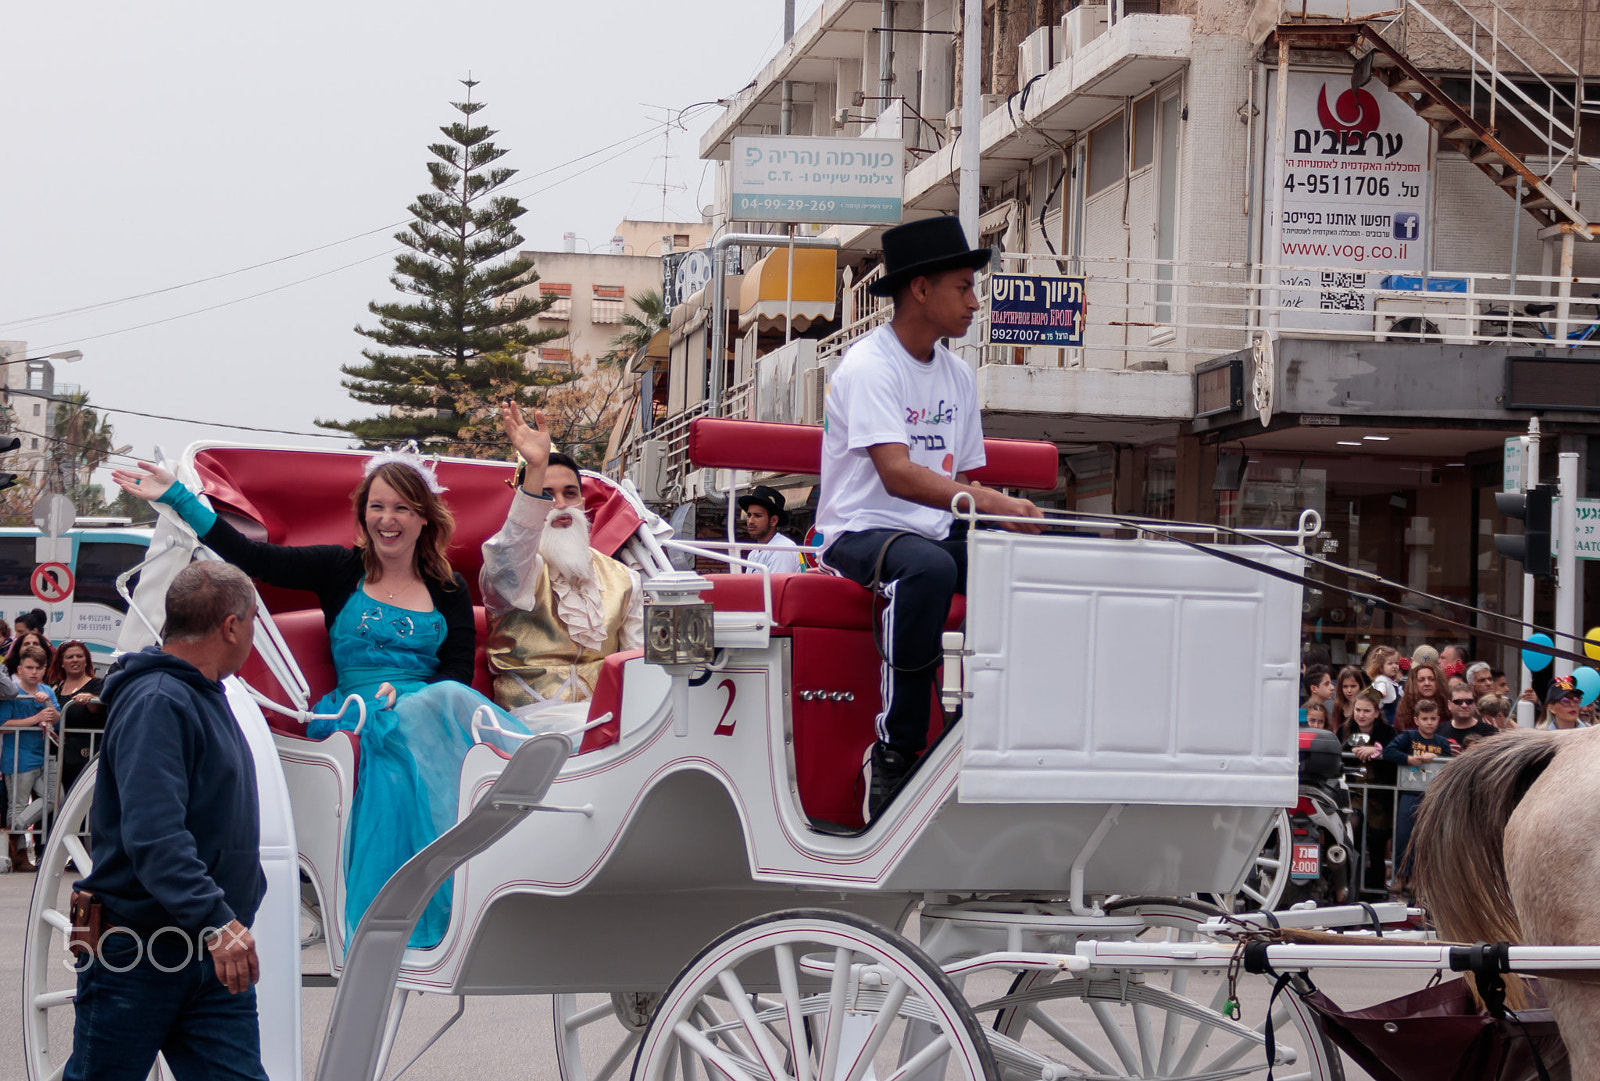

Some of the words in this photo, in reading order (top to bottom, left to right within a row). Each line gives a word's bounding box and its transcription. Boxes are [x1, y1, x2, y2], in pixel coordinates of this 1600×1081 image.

[1293, 129, 1404, 160] ערבובים
[768, 149, 820, 167] נהריה
[826, 151, 894, 169] פנורמה
[1296, 158, 1338, 169] לאומנויות
[1340, 160, 1382, 173] האקדמית
[1384, 161, 1421, 173] המכללה
[767, 170, 793, 182] C.T.
[812, 172, 850, 184] שיניים
[854, 172, 893, 185] צילומי
[1284, 173, 1390, 196] 4-9511706
[1397, 181, 1420, 198] טל.
[741, 198, 836, 212] 04-99-29-269
[1326, 213, 1357, 226] אותנו
[1360, 214, 1391, 227] חפשו
[1282, 242, 1408, 262] www.vog.co.il
[993, 279, 1036, 302] ברוש
[1041, 280, 1083, 309] תיווך
[991, 310, 1031, 325] КВАРТИРНОЕ
[1031, 312, 1049, 326] БЮРО
[1050, 309, 1073, 326] БРОШ
[991, 328, 1040, 341] 9927007
[713, 678, 737, 737] 2
